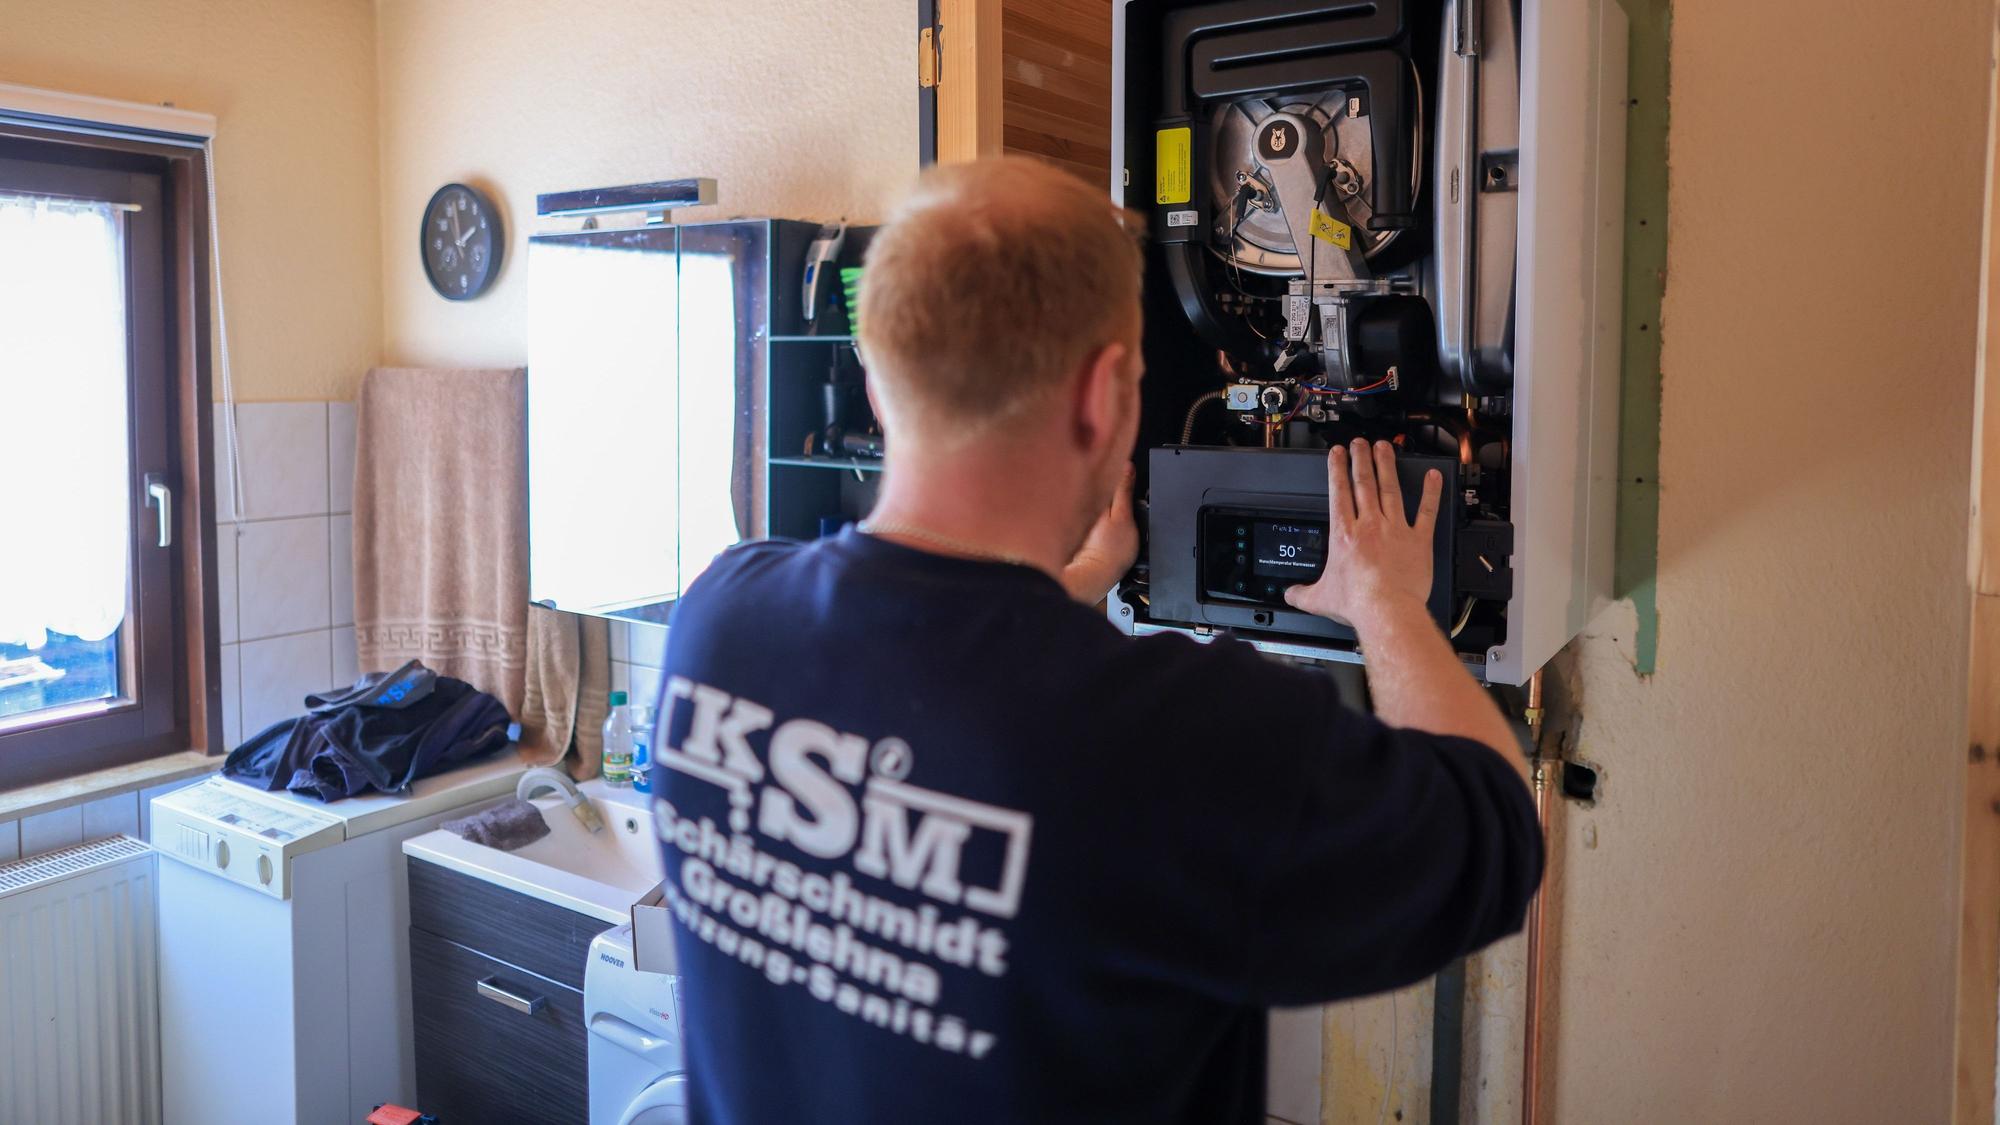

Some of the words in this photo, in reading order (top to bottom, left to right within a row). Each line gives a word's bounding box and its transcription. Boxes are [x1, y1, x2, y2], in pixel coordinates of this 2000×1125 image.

[1280, 545, 1296, 558] 50
[682, 682, 972, 904] KSM
[600, 953, 625, 969] HOOVER
[655, 798, 1010, 976] Schärschmidt
[681, 857, 943, 1007] Großlehna
